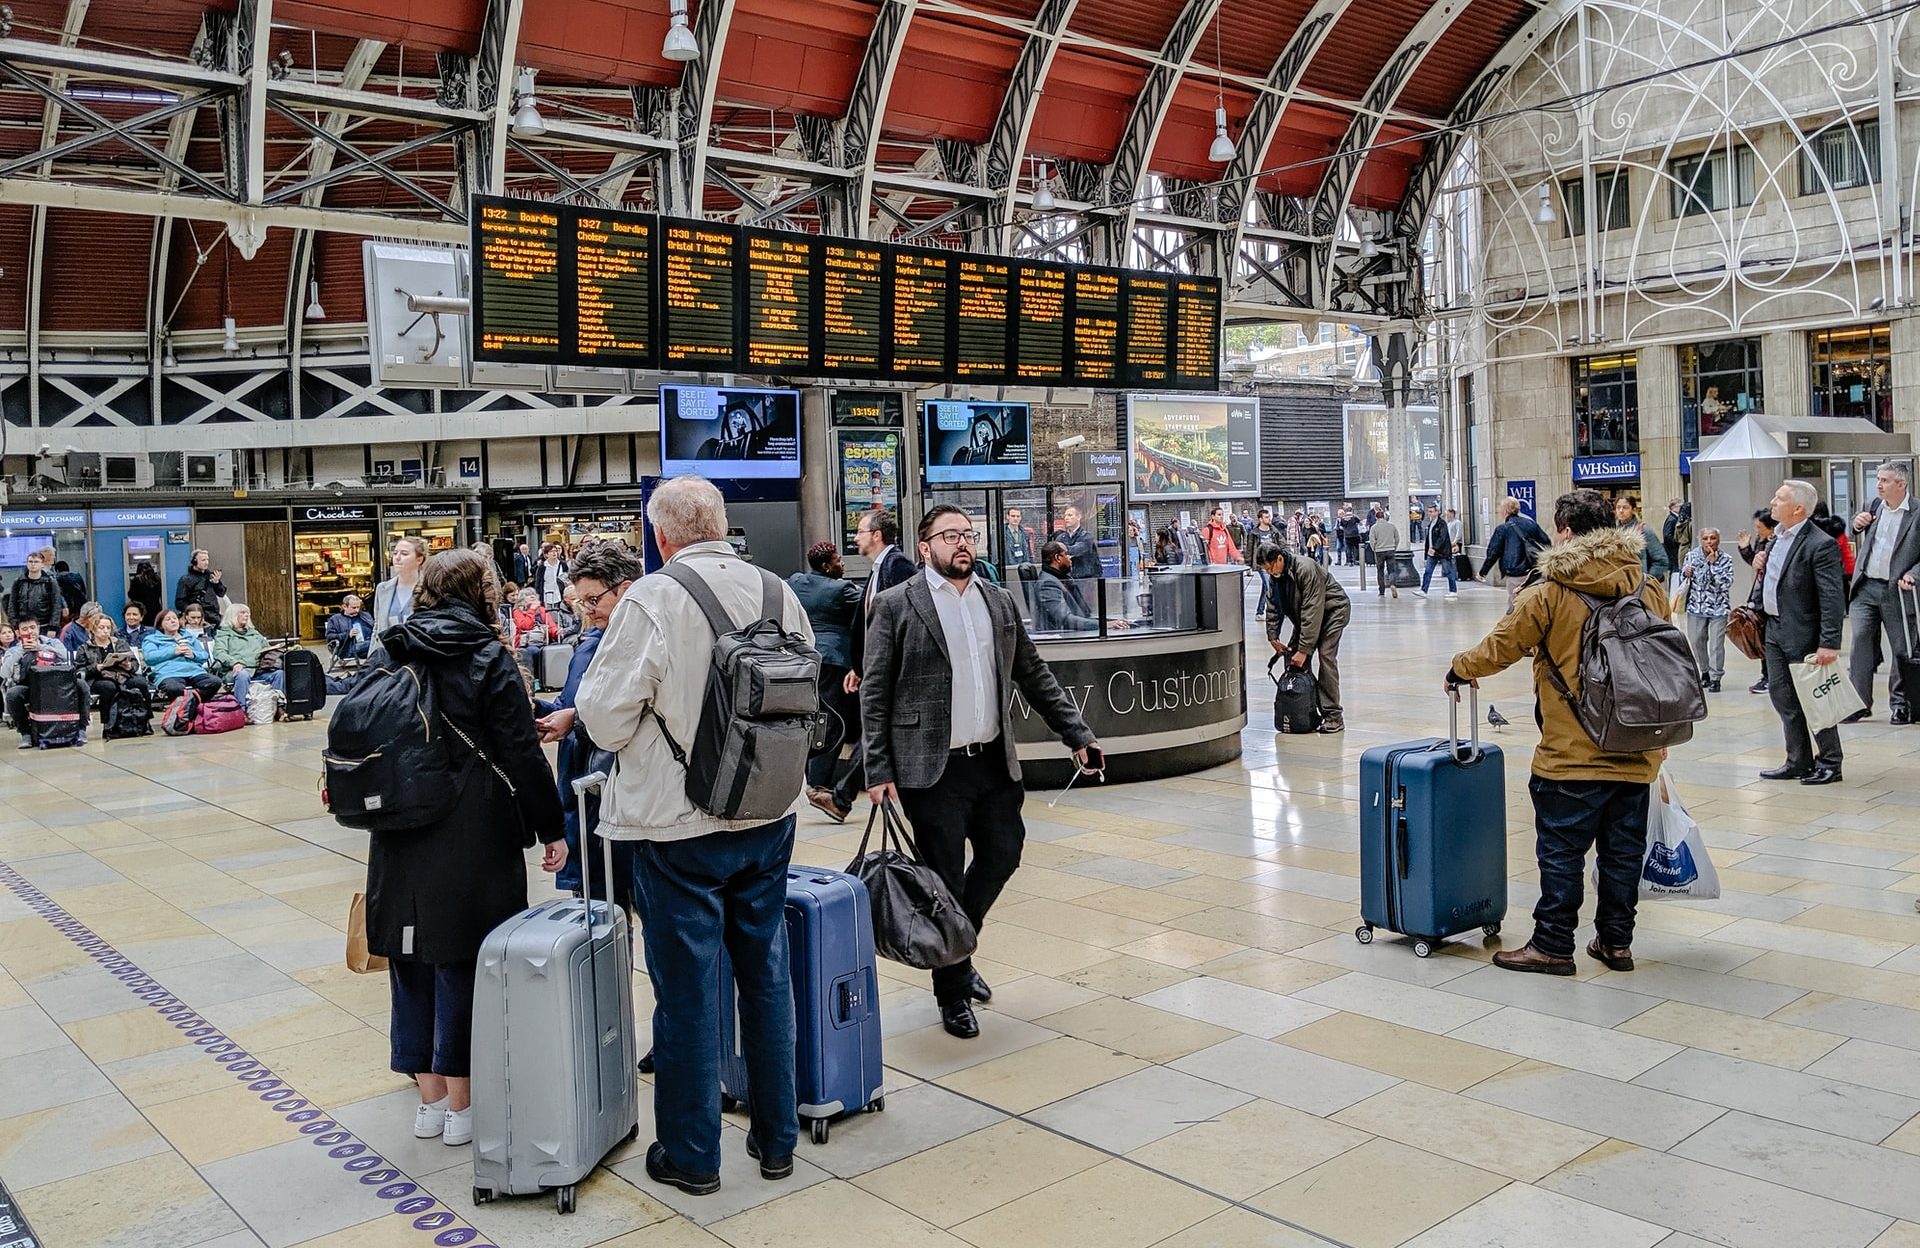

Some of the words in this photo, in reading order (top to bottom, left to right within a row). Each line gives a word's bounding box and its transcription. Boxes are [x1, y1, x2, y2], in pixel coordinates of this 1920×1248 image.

[483, 208, 507, 219] 13:22
[520, 212, 557, 225] Boarding
[482, 223, 516, 232] Worcester
[579, 219, 601, 229] 13:27
[613, 223, 648, 235] Boarding
[578, 231, 608, 243] Cholsey
[669, 229, 689, 239] 13:30
[696, 232, 732, 244] Preparing
[668, 240, 693, 251] Bristol
[704, 245, 726, 254] Meads
[751, 239, 770, 248] 13:33
[783, 243, 793, 251] Pls
[796, 244, 809, 253] wait
[750, 250, 782, 261] Heathrow
[785, 254, 802, 263] T234
[826, 247, 844, 256] 13:36
[868, 252, 880, 260] wait
[499, 255, 532, 264] Charlbury
[600, 256, 628, 264] Broadway
[826, 258, 860, 269] Cheltenham
[896, 255, 913, 264] 13:42
[896, 265, 920, 275] Twyford
[960, 273, 983, 282] Swansea
[1040, 280, 1064, 289] Harlington
[1076, 283, 1099, 291] Heathrow
[1100, 285, 1117, 293] Airport
[578, 300, 613, 308] Maidenhead
[680, 390, 696, 398] SEE
[845, 448, 894, 461] escape
[1090, 455, 1121, 465] Paddington
[377, 465, 392, 475] 12
[462, 461, 477, 473] 14
[1096, 467, 1117, 476] Station
[1577, 461, 1636, 475] WHSmith
[847, 474, 870, 484] YOUR
[1510, 487, 1533, 498] WH
[1649, 885, 1666, 893] Join
